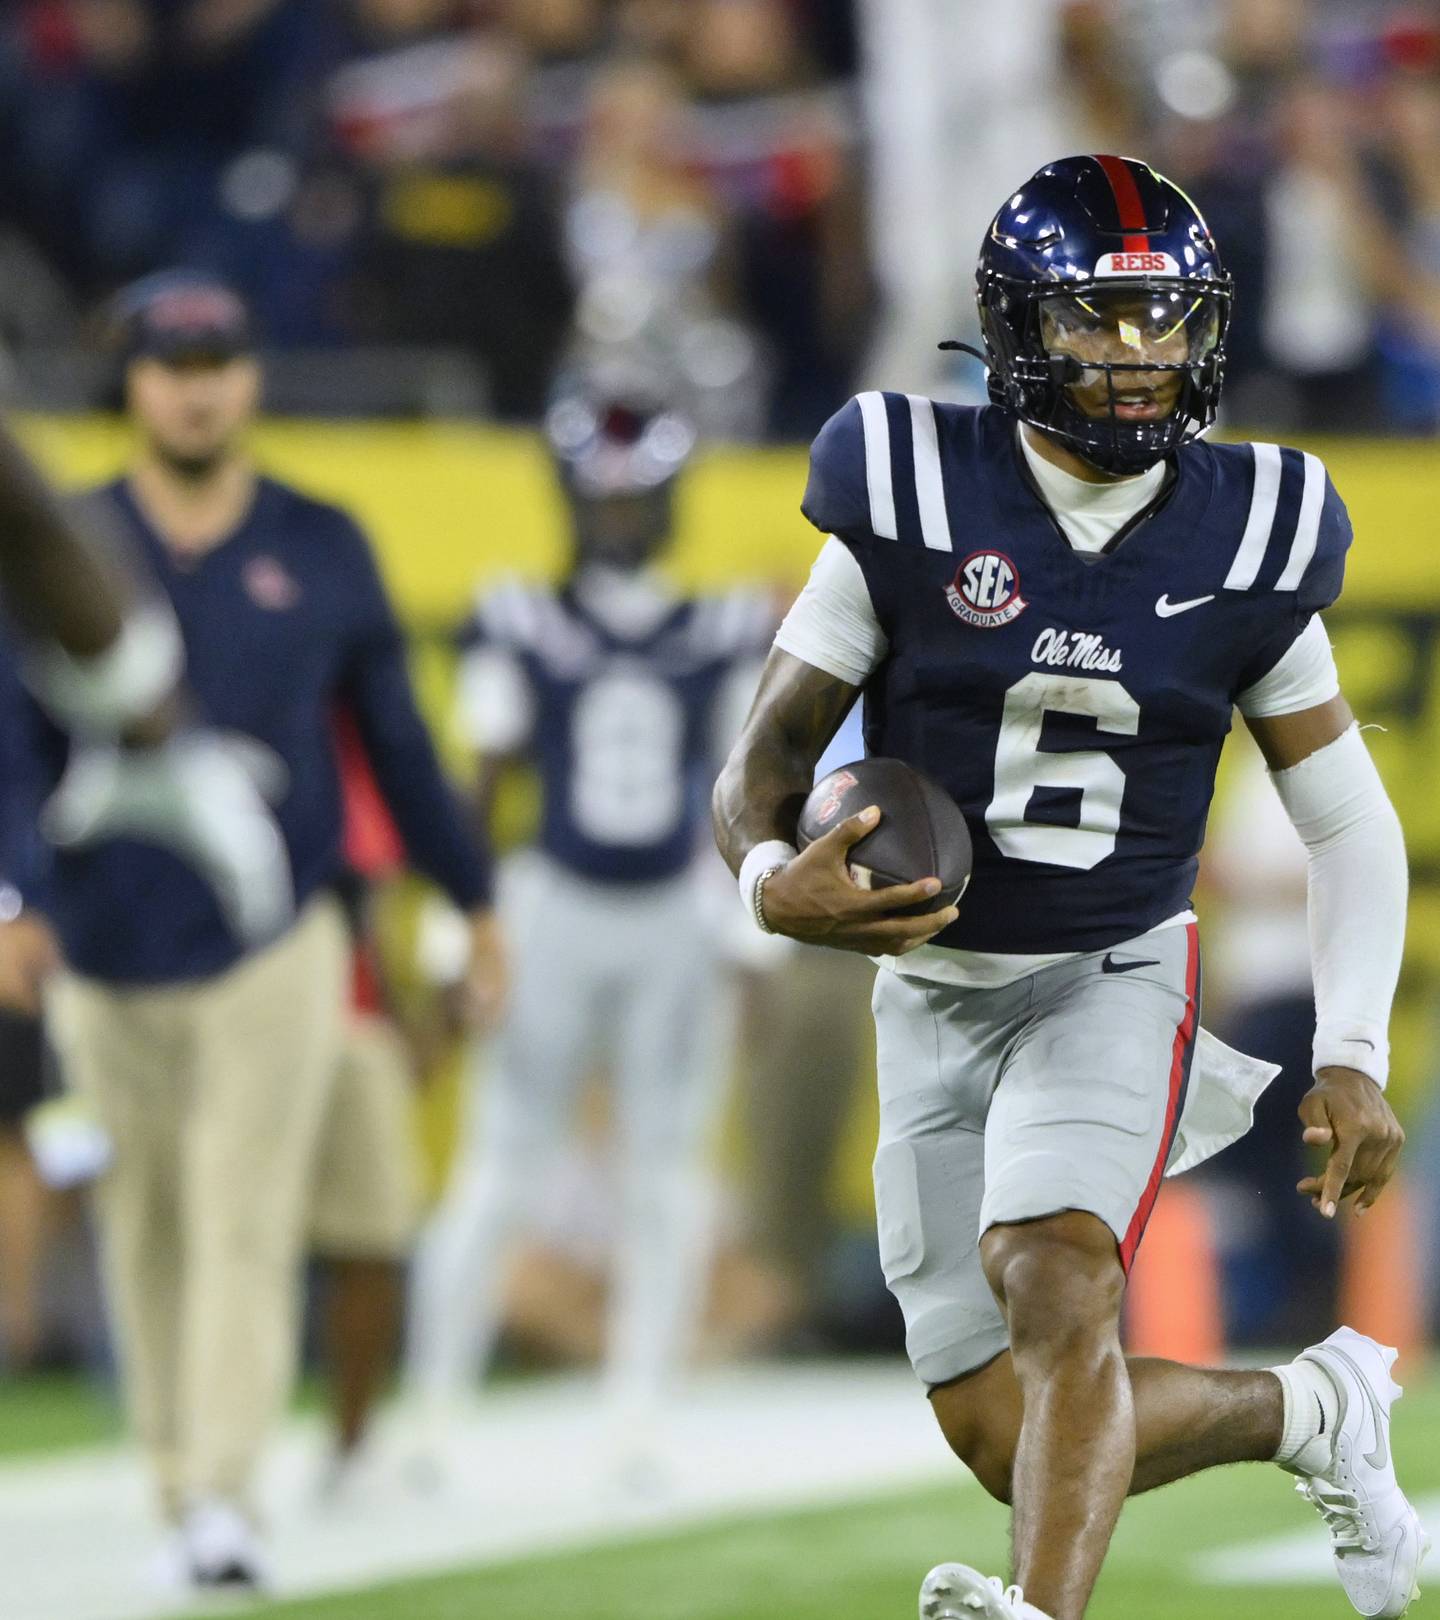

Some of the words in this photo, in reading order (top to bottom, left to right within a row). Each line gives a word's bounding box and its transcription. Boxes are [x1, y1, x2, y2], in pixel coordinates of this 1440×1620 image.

[1111, 254, 1166, 271] REBS
[961, 554, 1014, 609] SEC
[950, 596, 1013, 627] GRADUATE
[1031, 627, 1068, 666] Ole
[1067, 632, 1123, 673] Miss
[985, 672, 1140, 870] 6
